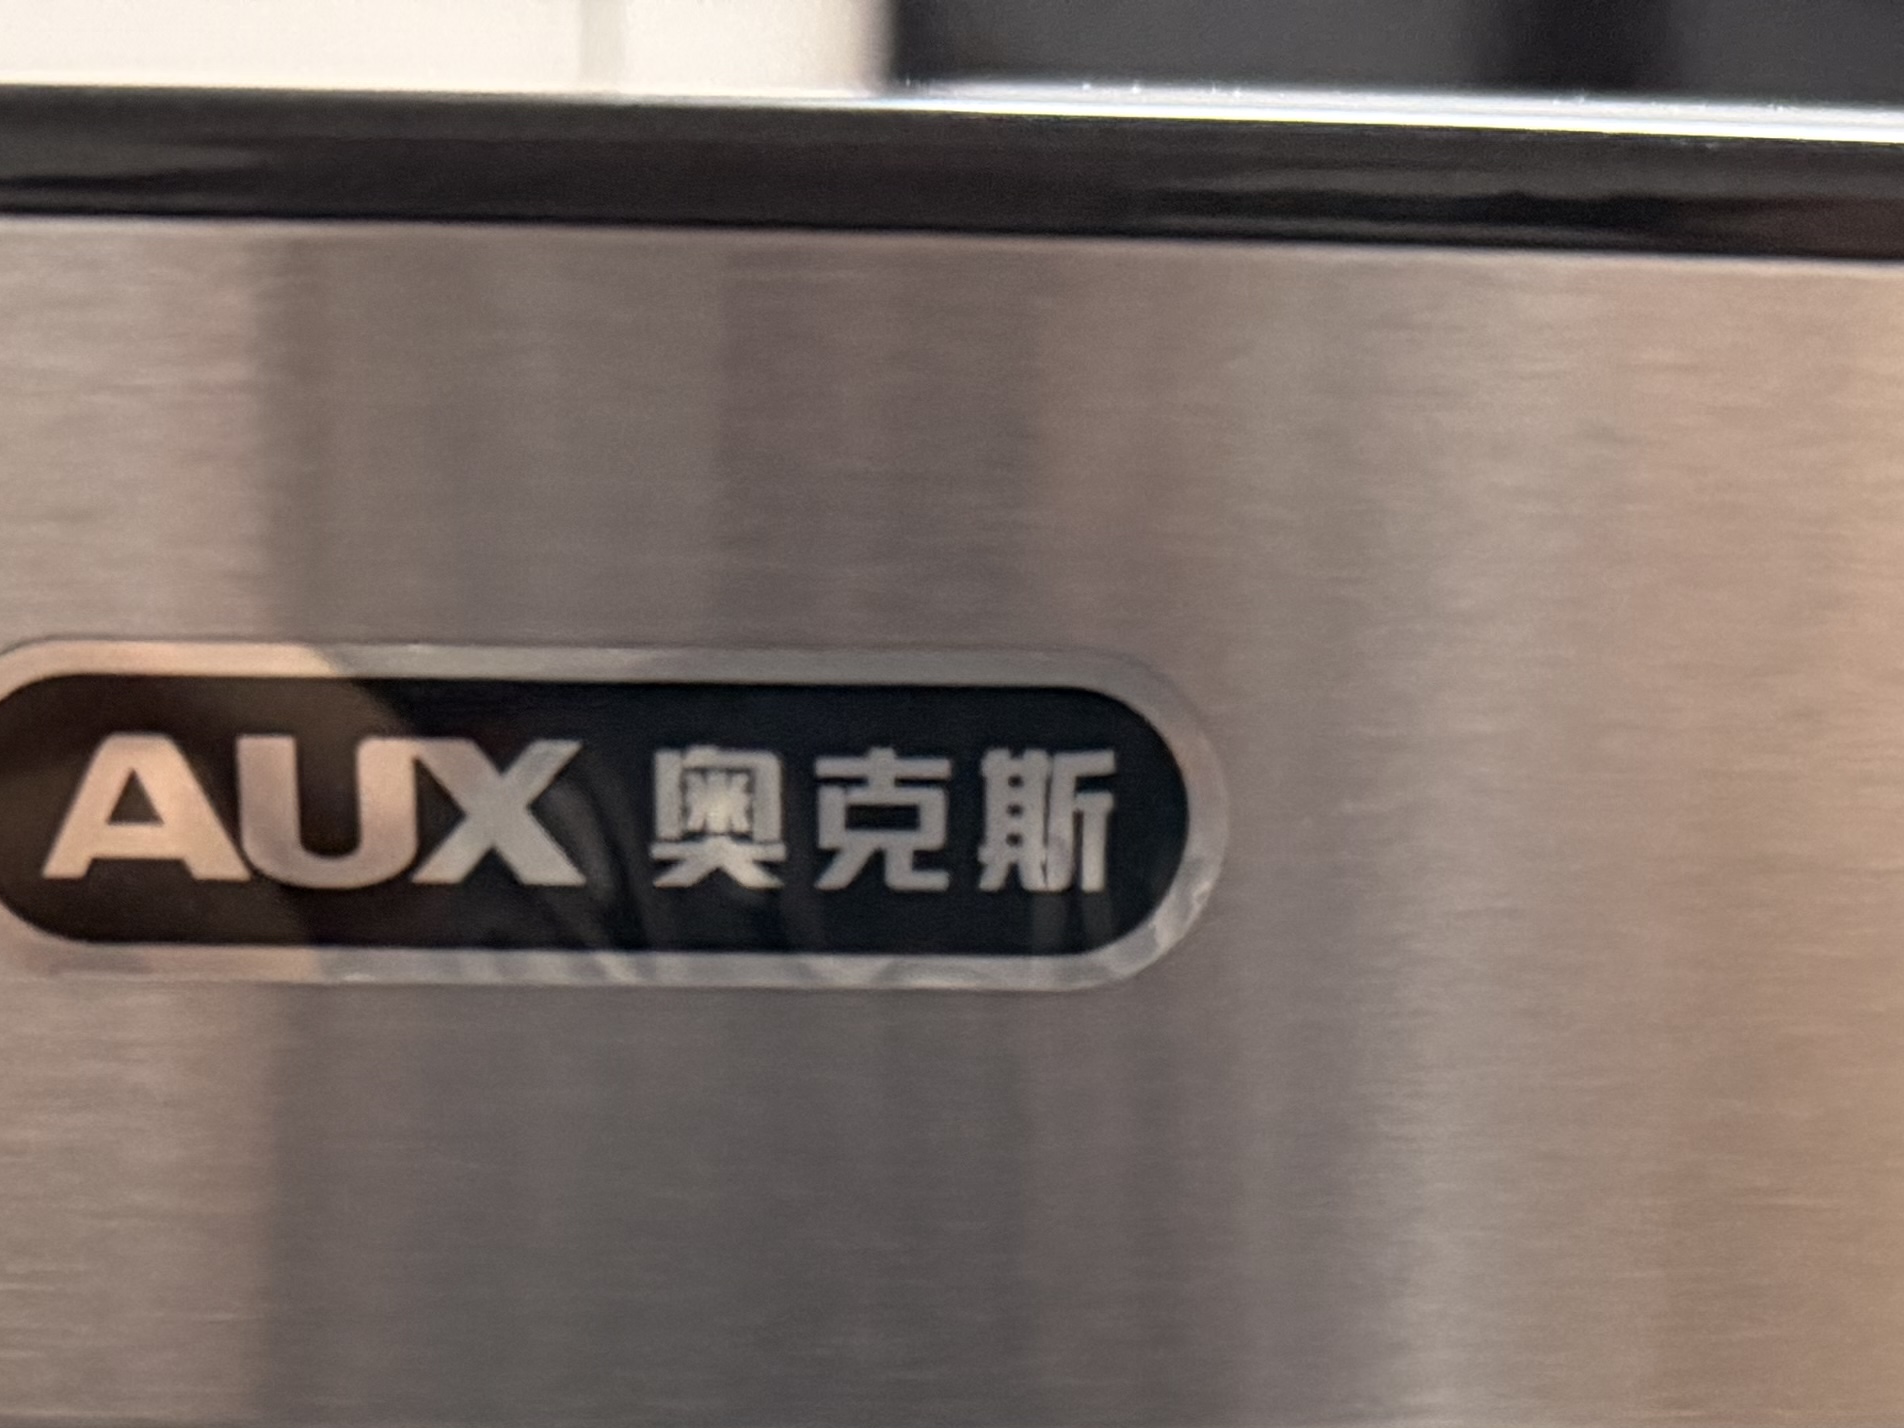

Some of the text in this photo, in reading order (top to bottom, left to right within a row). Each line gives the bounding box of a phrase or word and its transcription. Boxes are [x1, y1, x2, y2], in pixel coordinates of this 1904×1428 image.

[41, 731, 1117, 893] AUX 奥克斯
